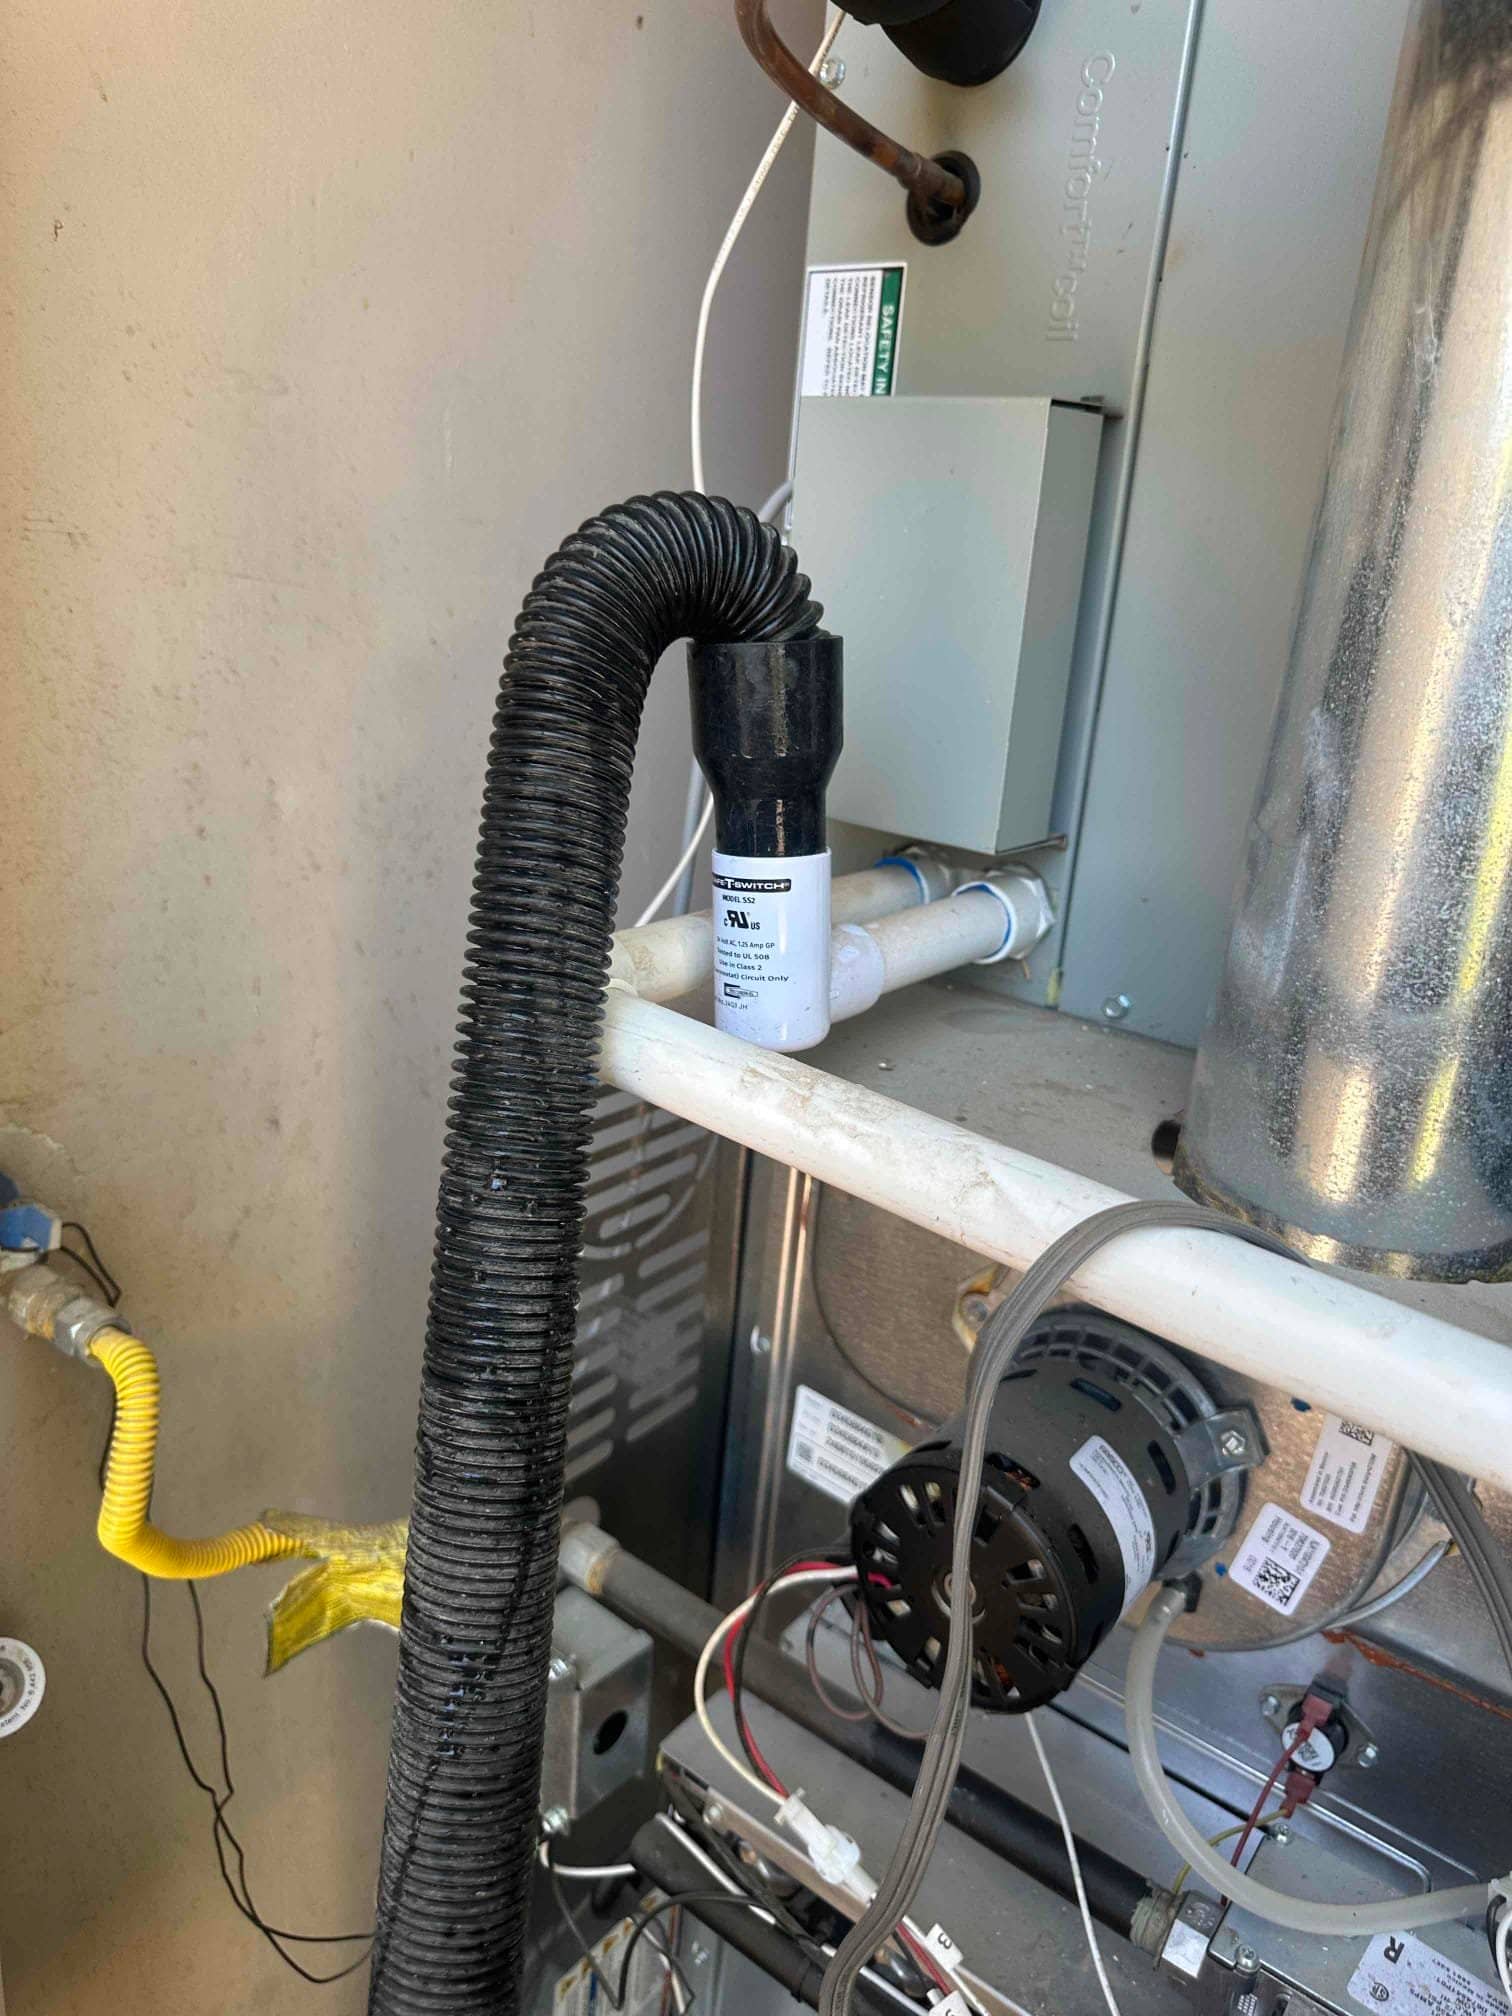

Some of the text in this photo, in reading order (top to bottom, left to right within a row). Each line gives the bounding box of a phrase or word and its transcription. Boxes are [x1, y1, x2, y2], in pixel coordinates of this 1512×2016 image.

[877, 304, 894, 373] SAFETY
[722, 894, 756, 904] MODEL SS2
[937, 1932, 953, 1950] 3
[1384, 1936, 1405, 1964] R
